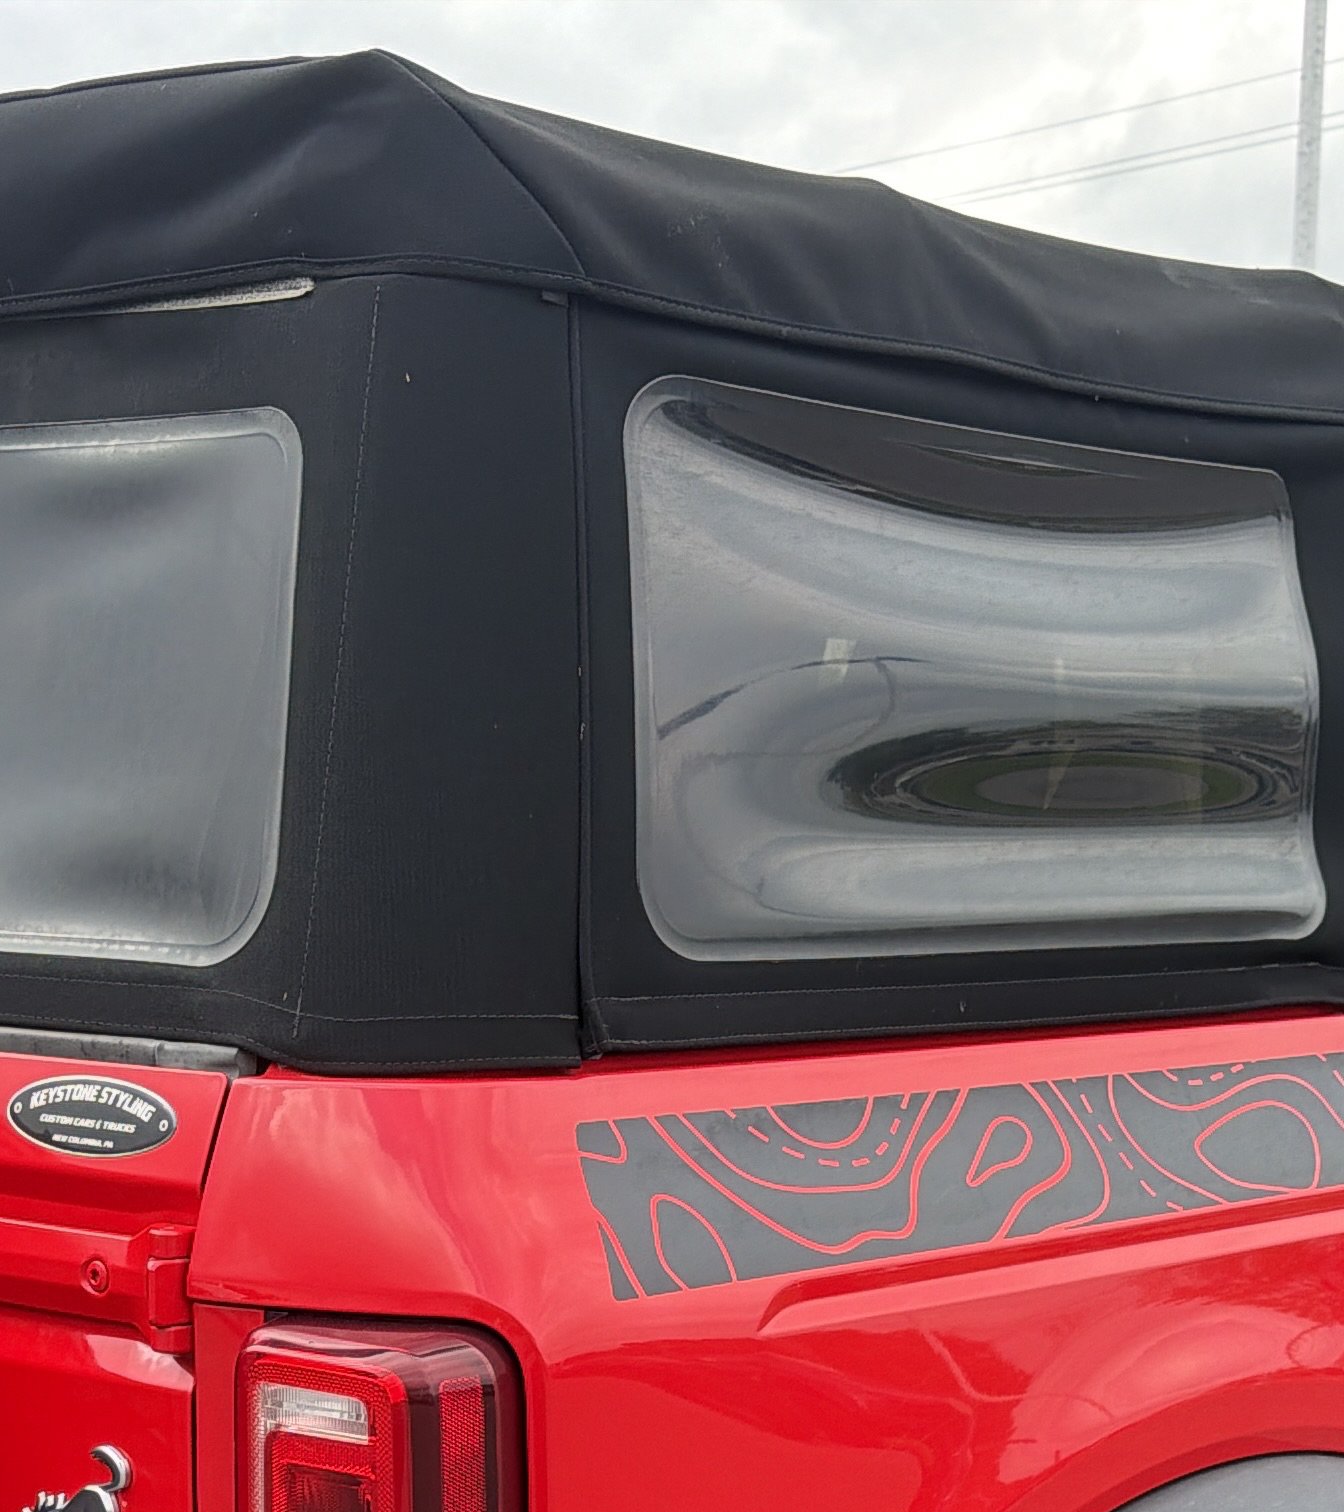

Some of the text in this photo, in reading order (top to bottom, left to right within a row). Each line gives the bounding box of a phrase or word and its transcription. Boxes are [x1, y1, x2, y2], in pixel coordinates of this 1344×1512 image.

[29, 1083, 157, 1123] KEYSTONE STYLING
[39, 1113, 74, 1126] CUSTOM
[73, 1115, 95, 1129] CARS
[102, 1120, 136, 1134] TRUCKS
[51, 1133, 68, 1143] NEW
[102, 1140, 114, 1149] PA
